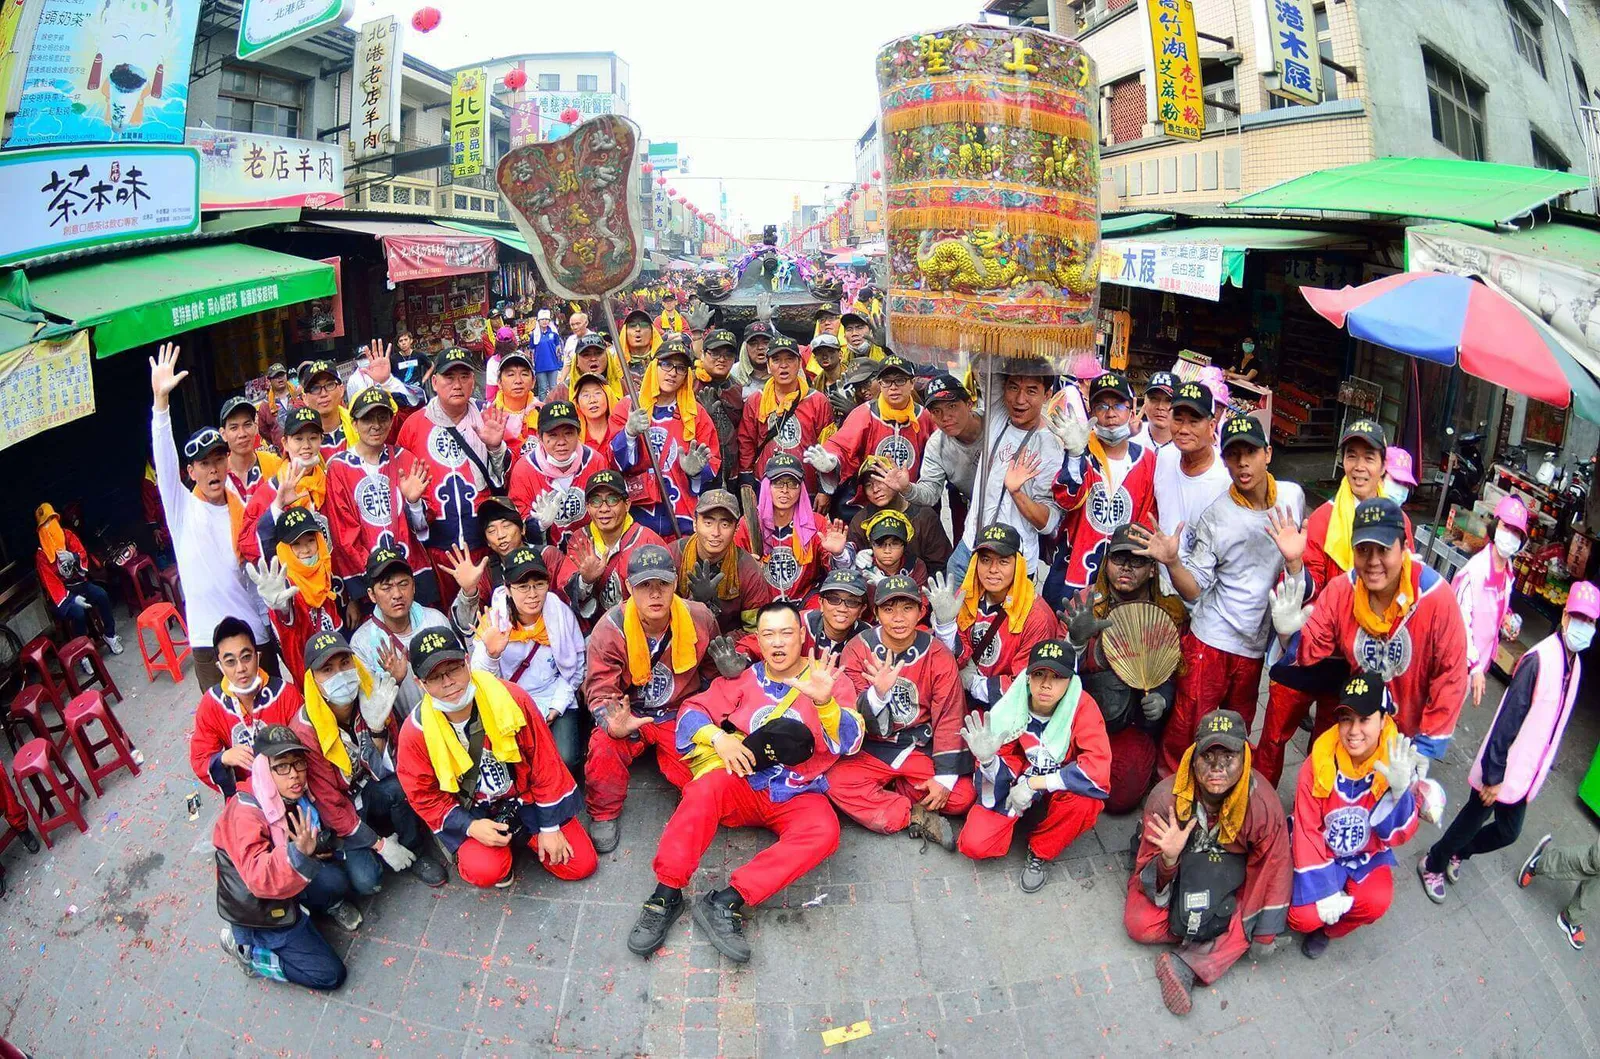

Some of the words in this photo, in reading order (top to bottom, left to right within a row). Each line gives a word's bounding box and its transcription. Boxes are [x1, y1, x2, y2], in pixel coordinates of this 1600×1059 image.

[272, 2, 307, 21] 北港店
[361, 23, 387, 151] 北港老店羊肉
[1180, 64, 1201, 126] 杏仁粉
[1167, 124, 1198, 137] 養生食品
[243, 142, 334, 183] 老店羊肉
[458, 165, 476, 176] 五金
[41, 164, 151, 227] 茶本味
[1121, 248, 1157, 284] 木屐
